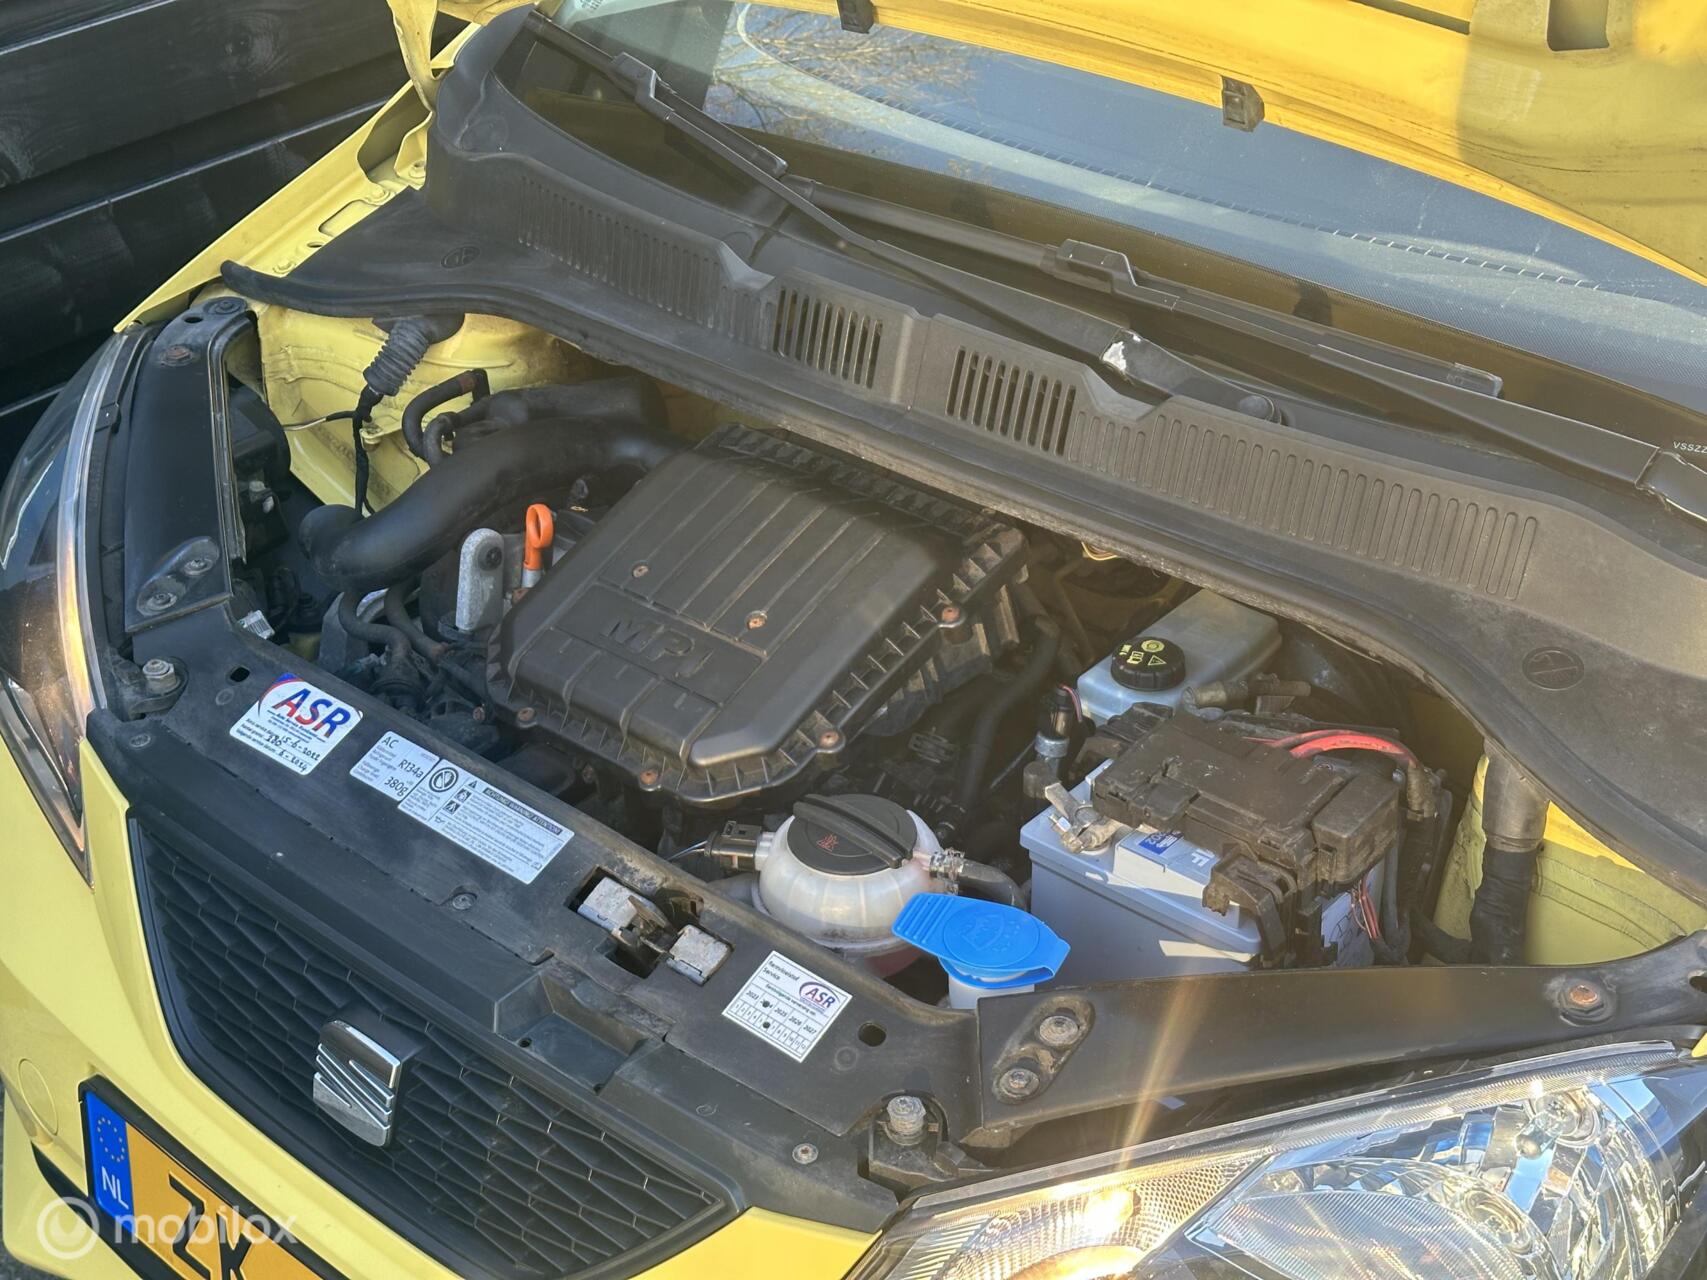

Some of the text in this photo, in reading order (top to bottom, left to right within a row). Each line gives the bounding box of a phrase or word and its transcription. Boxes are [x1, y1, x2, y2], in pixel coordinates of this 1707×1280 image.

[272, 688, 352, 738] ASR
[381, 736, 399, 749] AC
[397, 758, 424, 778] R134a
[383, 776, 409, 797] 380g
[805, 987, 835, 1009] ASR
[101, 1166, 130, 1210] NL
